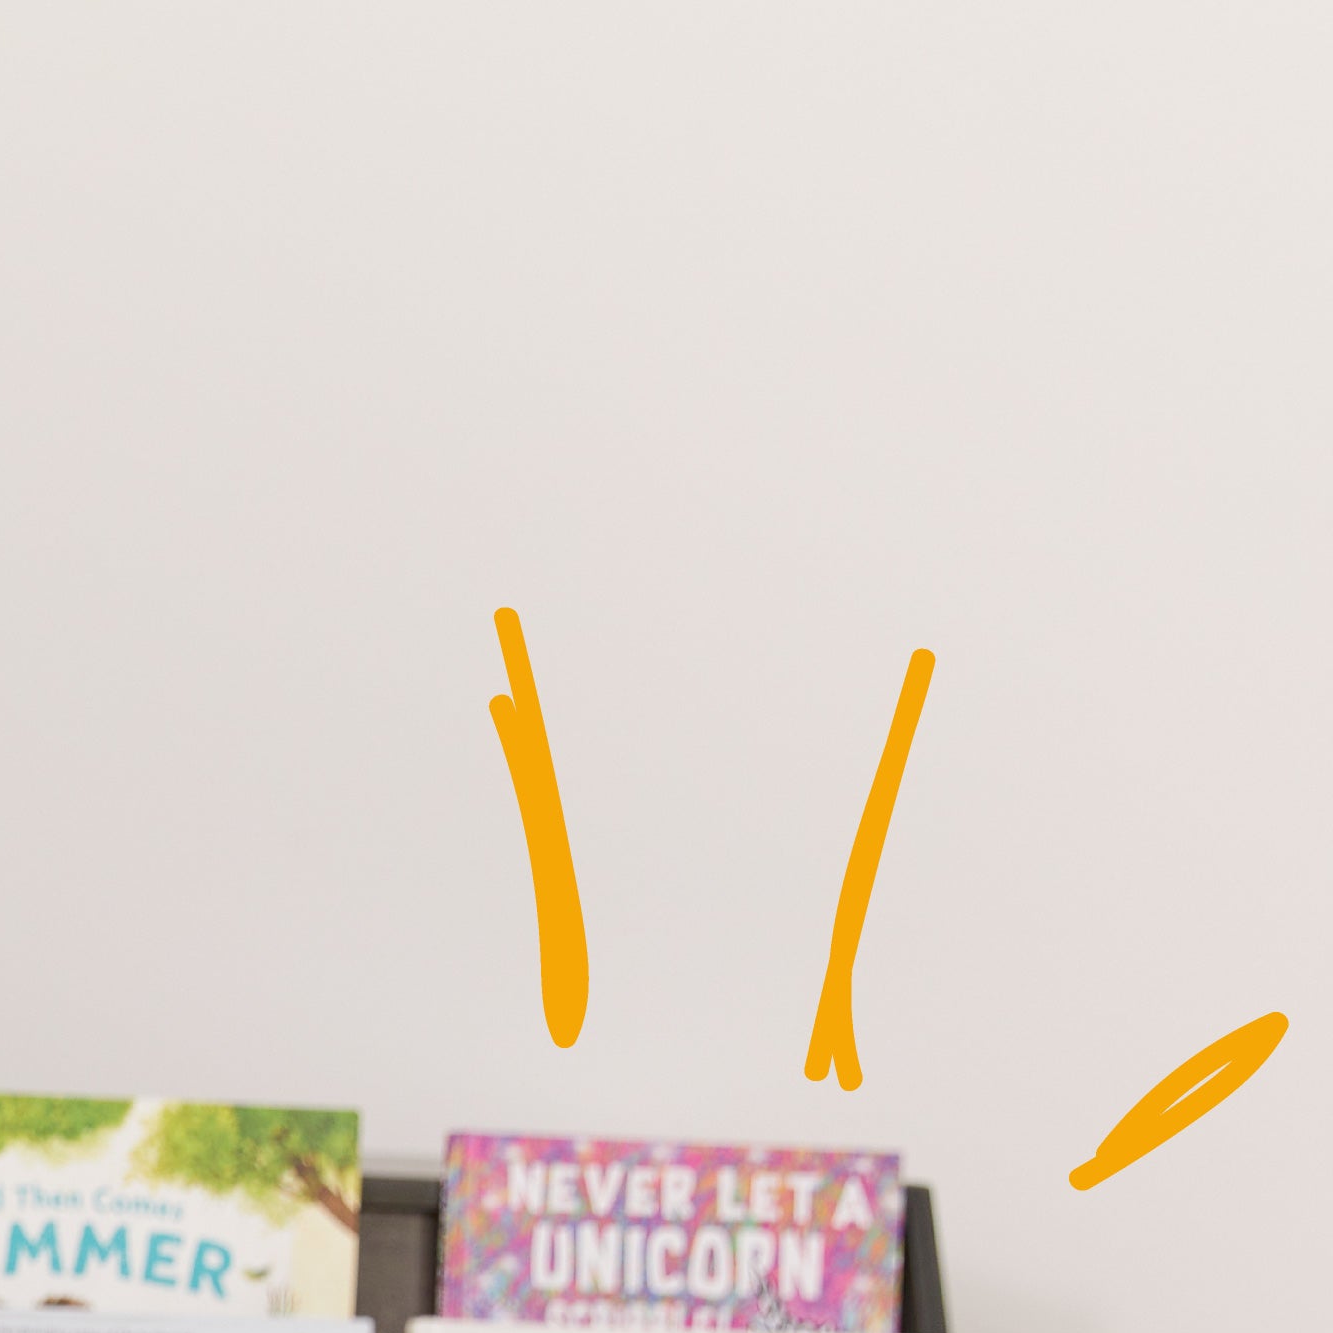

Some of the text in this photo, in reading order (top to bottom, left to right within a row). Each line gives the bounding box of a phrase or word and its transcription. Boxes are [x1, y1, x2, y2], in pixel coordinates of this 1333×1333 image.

[17, 1184, 83, 1209] Then
[93, 1187, 183, 1219] Comes
[507, 1162, 874, 1231] NEVER LET A
[532, 1219, 825, 1301] UNICORN
